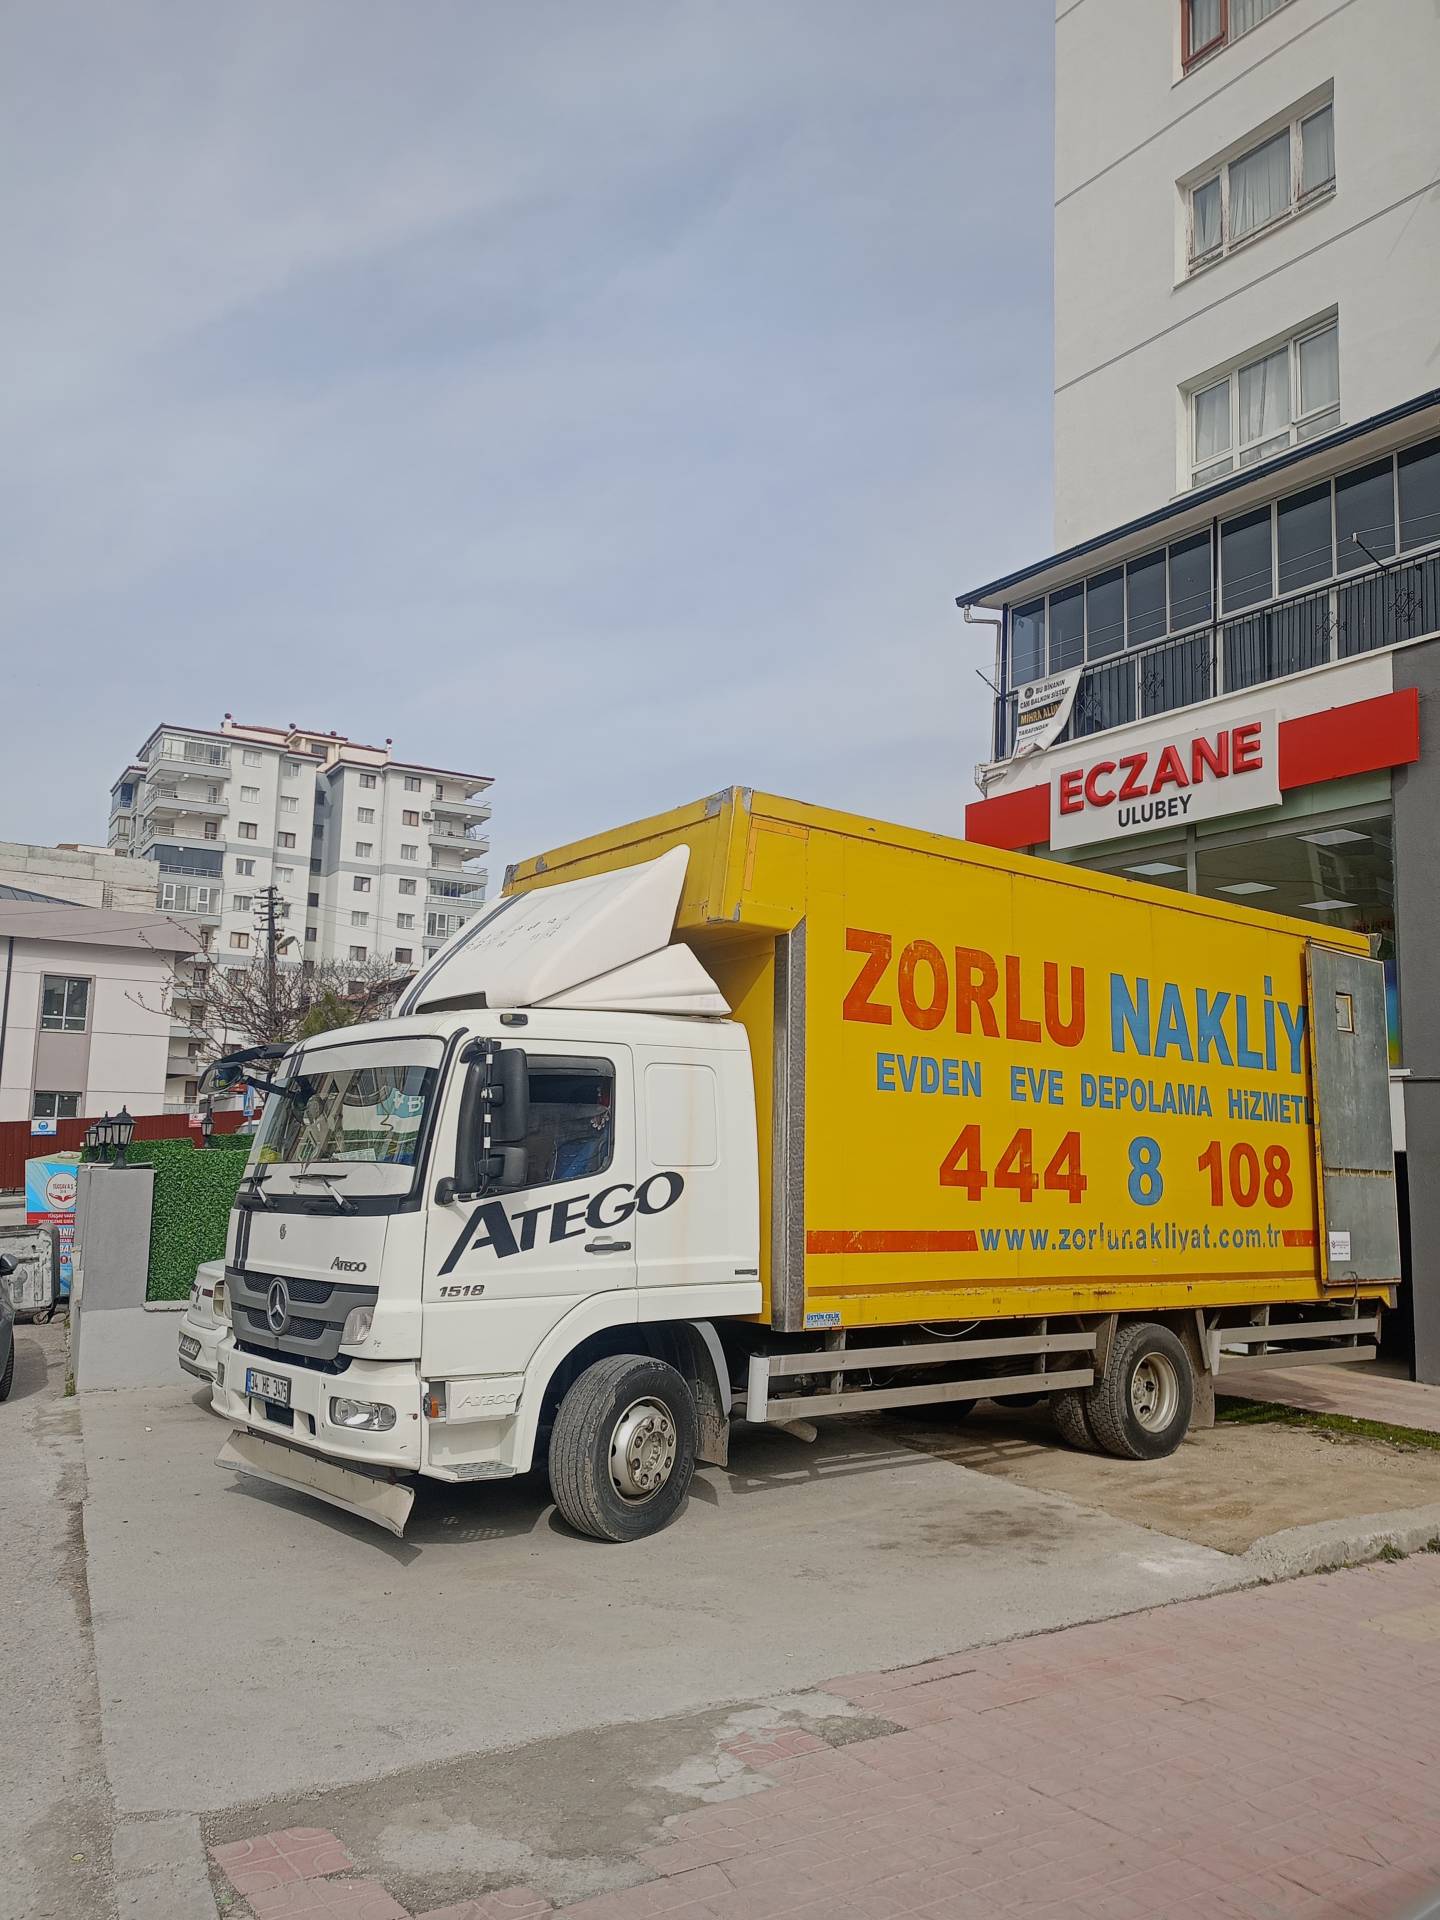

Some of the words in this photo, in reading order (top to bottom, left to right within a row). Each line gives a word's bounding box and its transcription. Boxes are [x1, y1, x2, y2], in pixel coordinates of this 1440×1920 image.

[1035, 686, 1043, 695] BU
[1060, 721, 1263, 815] ECZANE
[1117, 794, 1192, 828] ULUBEY
[842, 927, 1087, 1048] ZORLU
[876, 1052, 982, 1097] EVDEN
[1010, 1066, 1064, 1106] EVE
[1080, 1074, 1213, 1118] DEPOLAMA
[938, 1123, 1089, 1206] 444
[1127, 1136, 1164, 1207] 8
[1197, 1140, 1294, 1210] 108
[437, 1171, 685, 1276] ATEGO
[439, 1284, 485, 1298] 1518
[250, 1372, 258, 1391] 34
[262, 1375, 269, 1394] HE
[273, 1379, 287, 1401] 3475
